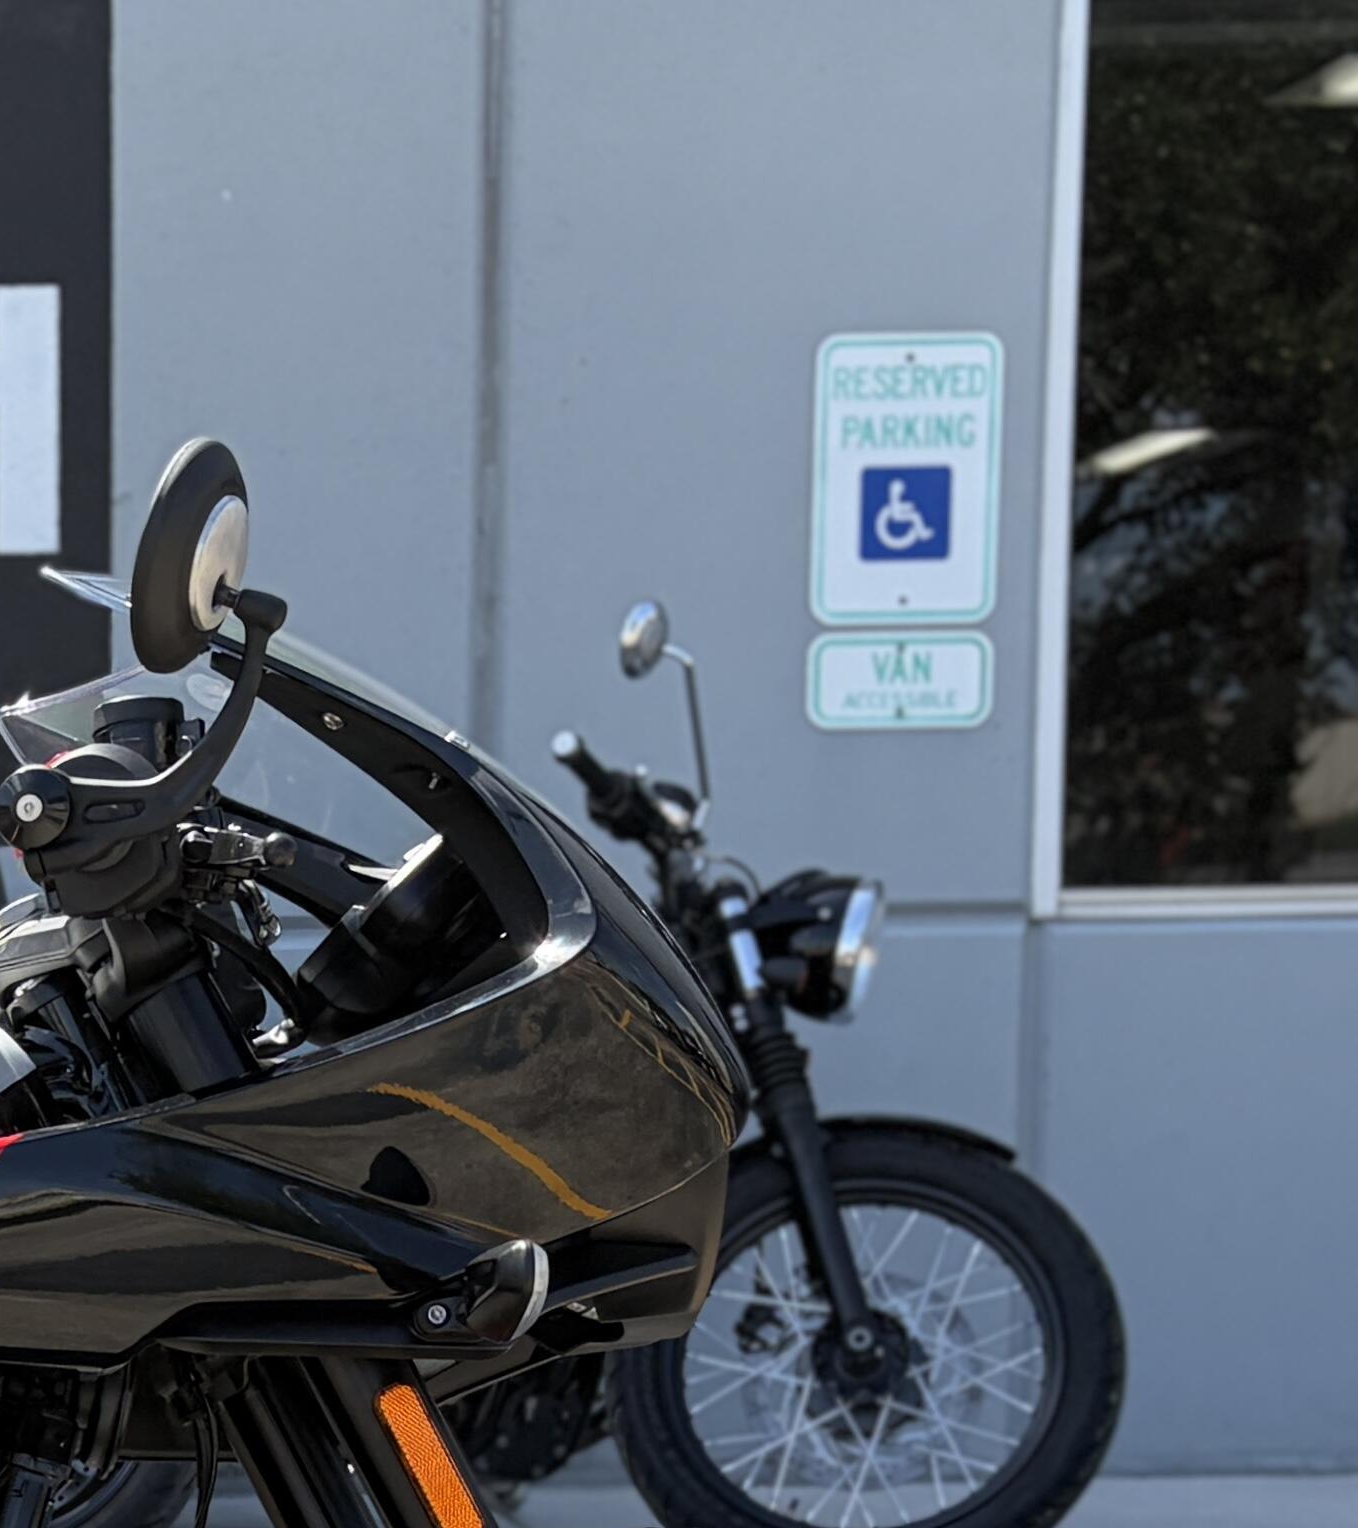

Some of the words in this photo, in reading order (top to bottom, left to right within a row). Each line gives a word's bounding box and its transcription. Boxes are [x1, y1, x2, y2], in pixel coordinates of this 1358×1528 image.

[832, 363, 988, 400] RESERVED
[841, 413, 978, 450] PARKING
[871, 651, 933, 684] VAN
